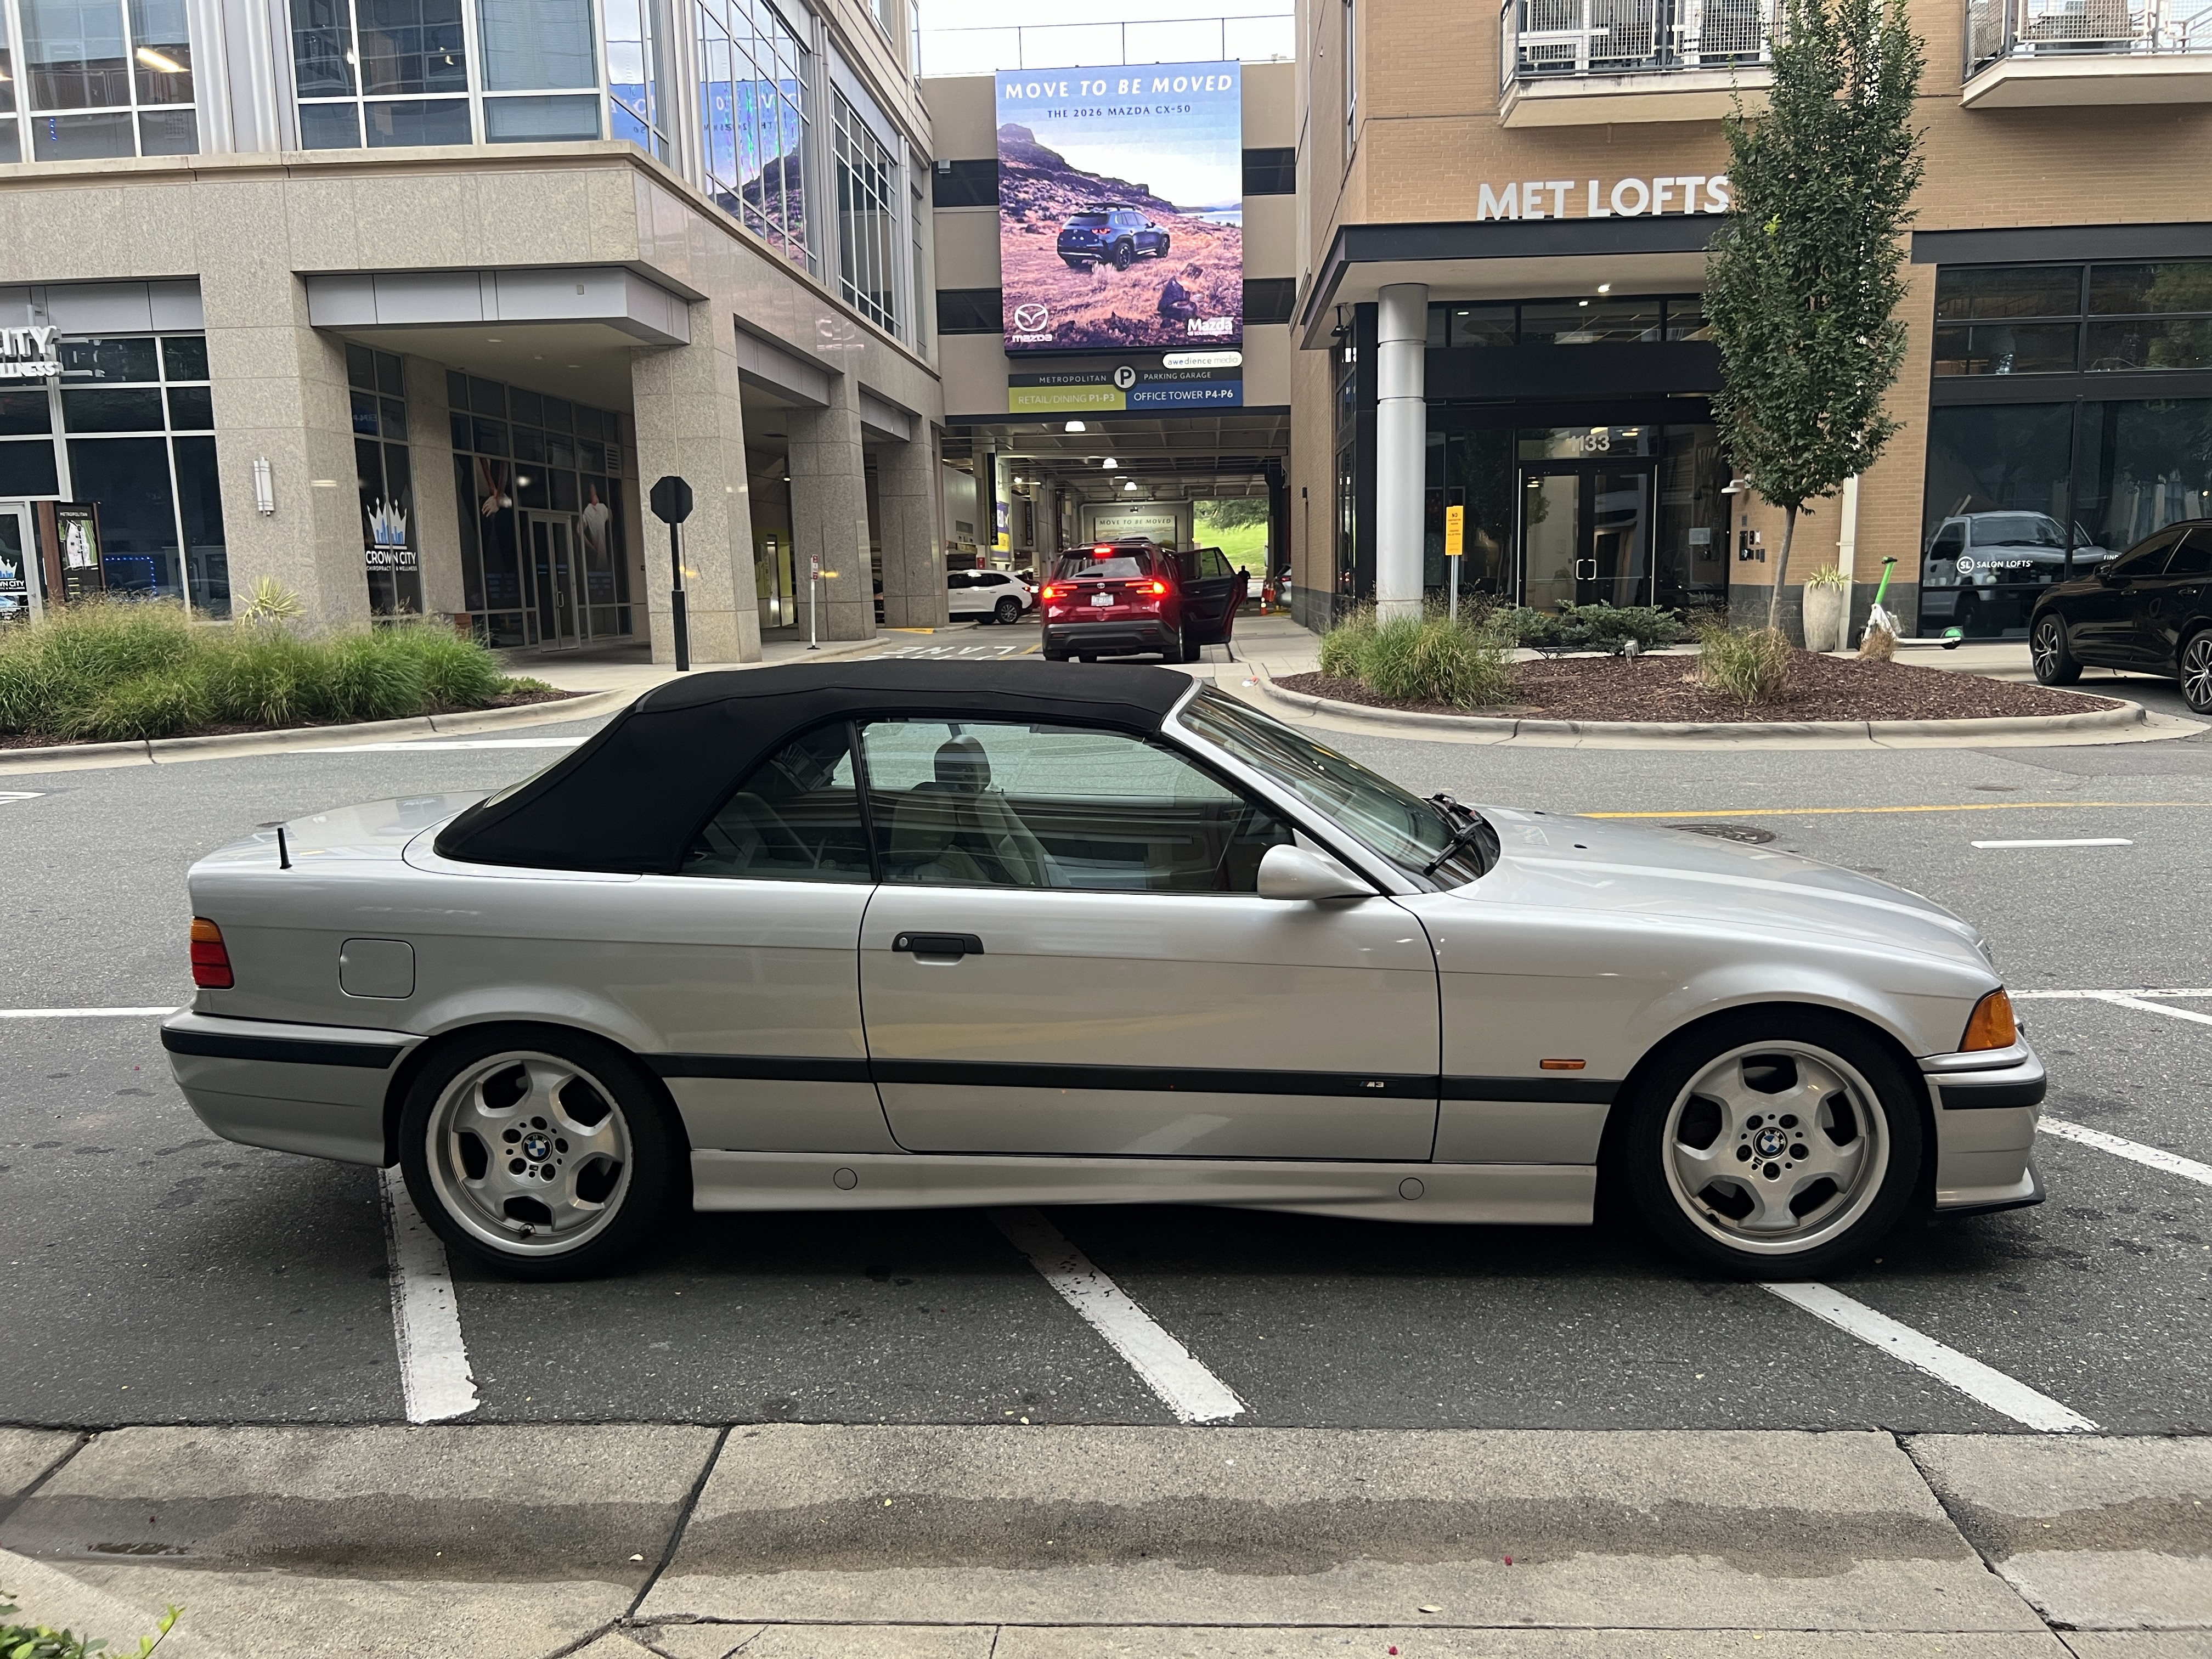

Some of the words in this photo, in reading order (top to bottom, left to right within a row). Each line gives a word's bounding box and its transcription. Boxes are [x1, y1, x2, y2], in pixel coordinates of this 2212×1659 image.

[1006, 81, 1069, 99] MOVE
[1080, 80, 1107, 96] TO
[1118, 78, 1142, 94] BE
[1152, 75, 1232, 93] MOVED
[1047, 110, 1068, 118] THE
[1074, 108, 1102, 117] 2026
[1108, 106, 1150, 116] MAZDA
[1156, 105, 1191, 114] CX-50
[1476, 181, 1575, 221] MET
[1588, 176, 1730, 217] LOFTS
[1187, 317, 1233, 332] Mazda
[0, 326, 57, 356] ITY
[1012, 334, 1053, 342] mazda
[1168, 357, 1212, 365] awedience
[1039, 375, 1107, 383] METROPOLITAN
[1120, 369, 1132, 385] P
[1018, 394, 1086, 404] RETAIL/DINING
[1089, 394, 1115, 402] P1-P3
[1133, 392, 1166, 402] OFFICE
[1169, 391, 1203, 400] TOWER
[1205, 390, 1233, 399] P4-P6
[1570, 435, 1610, 452] 1133
[366, 550, 398, 564] CROWN
[399, 552, 416, 565] CITY
